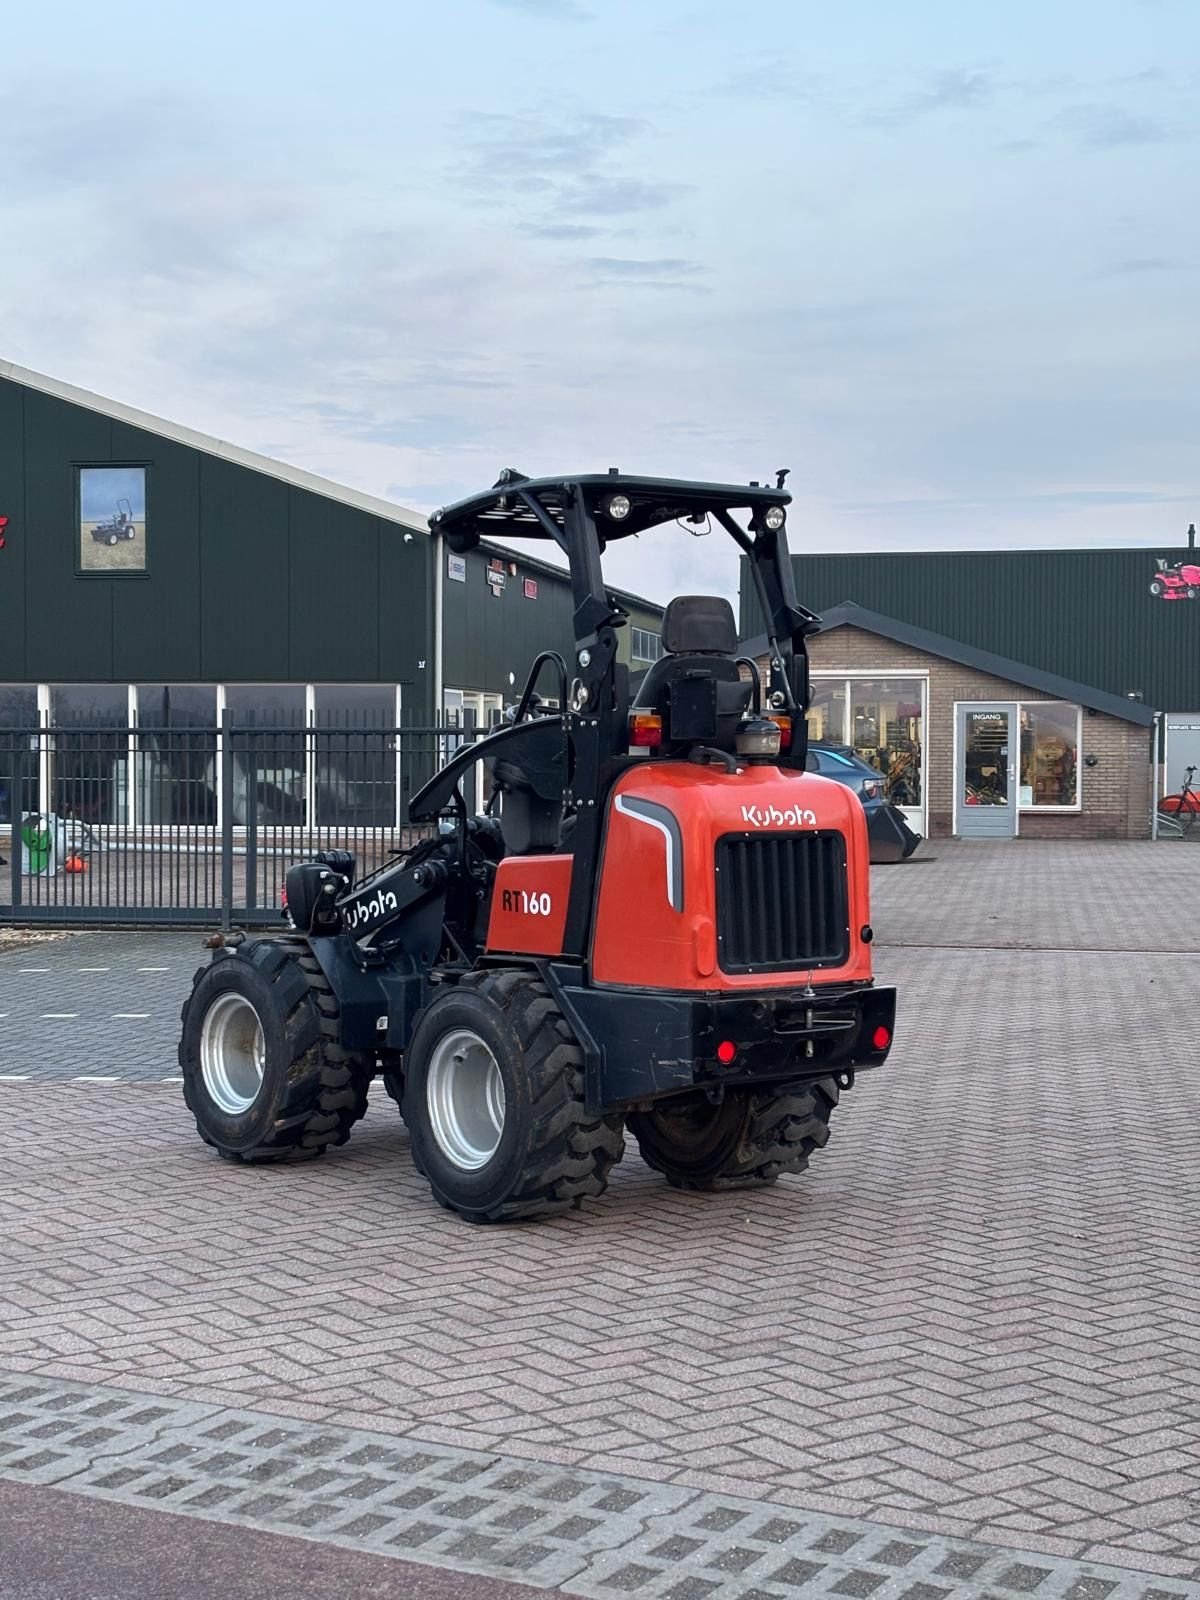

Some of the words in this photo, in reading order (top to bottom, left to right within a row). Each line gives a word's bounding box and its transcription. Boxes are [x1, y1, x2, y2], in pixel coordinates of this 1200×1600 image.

[972, 713, 1001, 721] INGANG
[741, 804, 817, 827] Kubota
[342, 889, 398, 929] ubota
[502, 889, 551, 916] RT160
